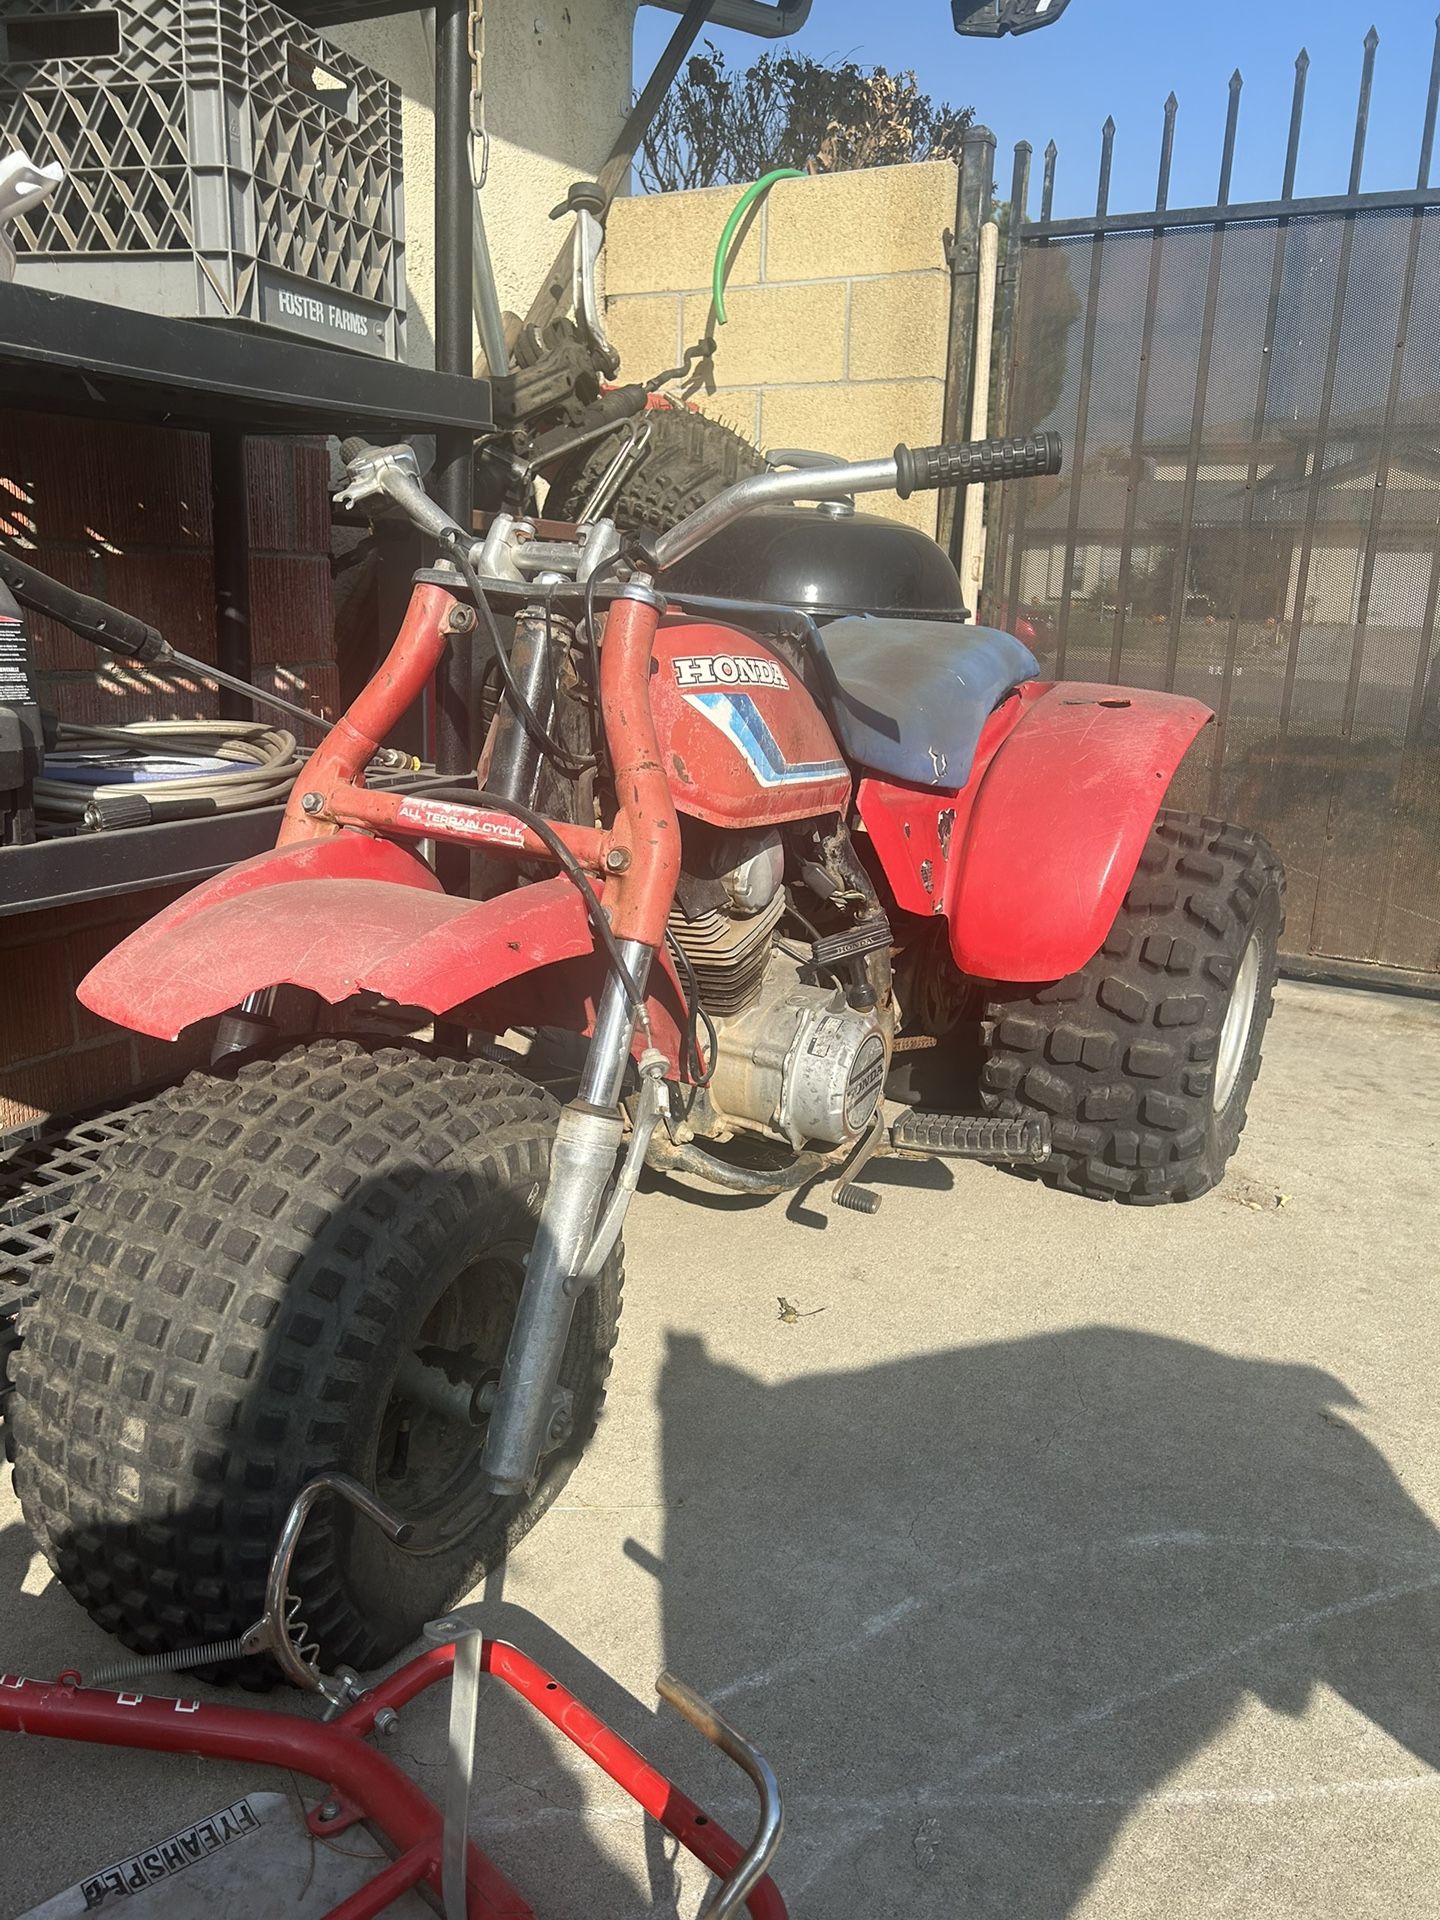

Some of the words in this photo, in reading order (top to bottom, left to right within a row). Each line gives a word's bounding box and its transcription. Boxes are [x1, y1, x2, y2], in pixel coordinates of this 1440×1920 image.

[279, 289, 324, 323] FOSTER
[328, 305, 369, 336] FARMS
[672, 655, 789, 689] HONDA
[399, 806, 421, 820] ALL
[424, 811, 480, 830] TERRAIN
[481, 822, 524, 838] CYCLE
[836, 937, 874, 954] HONDA
